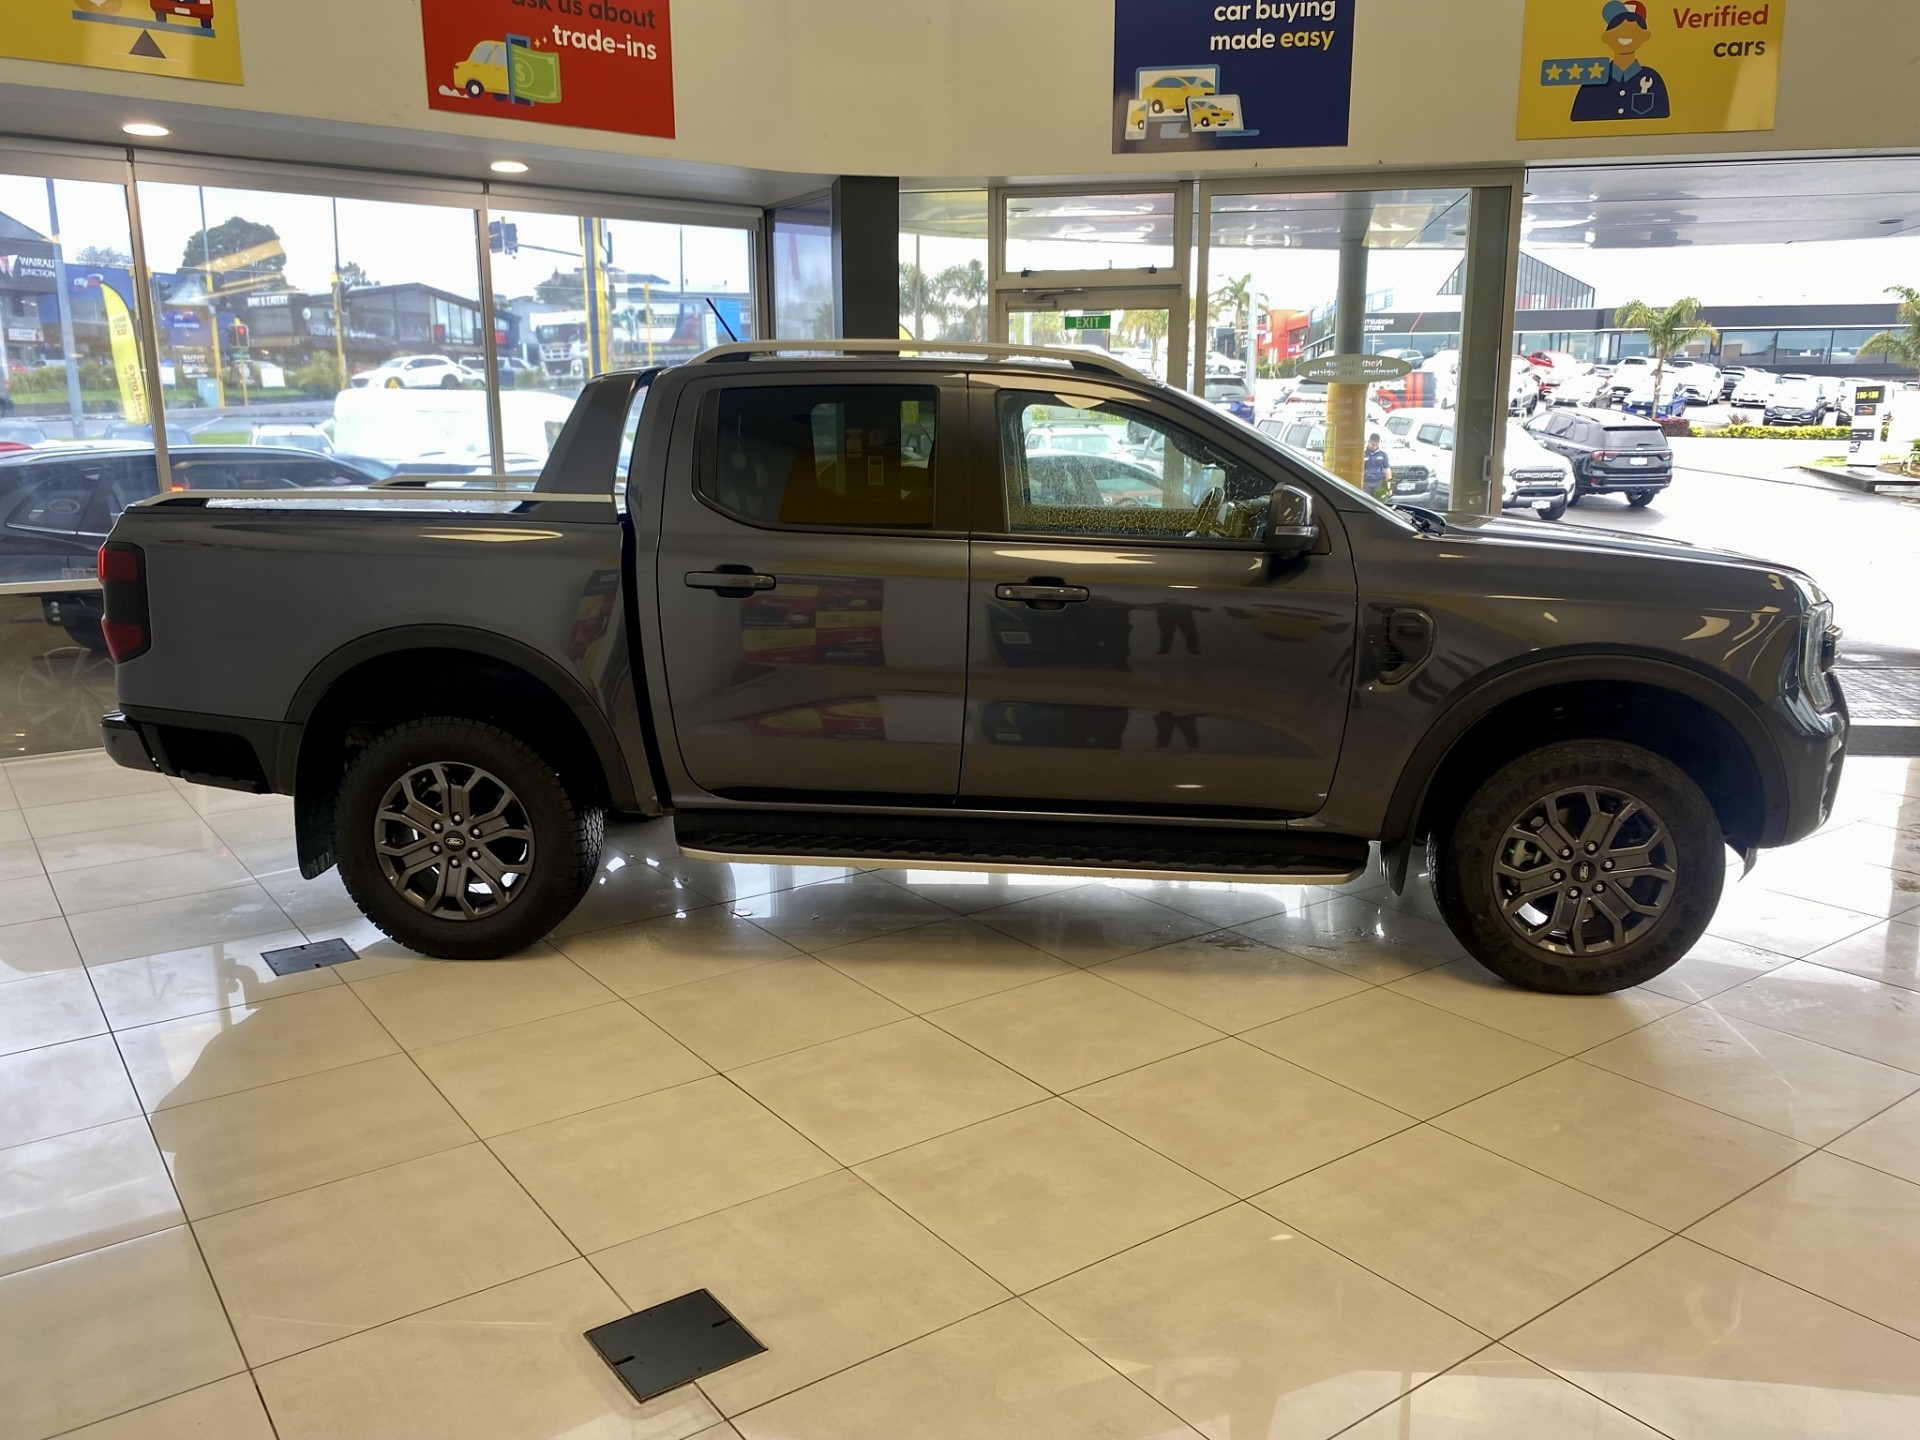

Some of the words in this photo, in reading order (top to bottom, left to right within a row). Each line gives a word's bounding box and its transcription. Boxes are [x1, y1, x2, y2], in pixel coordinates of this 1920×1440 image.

[558, 0, 584, 16] us
[588, 2, 656, 29] about
[1214, 4, 1251, 21] car
[1255, 0, 1336, 23] buying
[1673, 4, 1769, 29] Verified
[552, 24, 657, 61] trade-ins
[1210, 28, 1276, 51] made
[1280, 30, 1335, 51] easy
[1713, 40, 1765, 57] cars
[19, 257, 55, 269] WAIRAU
[21, 268, 56, 278] JUNCTION
[1076, 316, 1100, 329] EXIT
[1363, 324, 1385, 332] OTORS
[1364, 318, 1395, 326] ITSUBISHI
